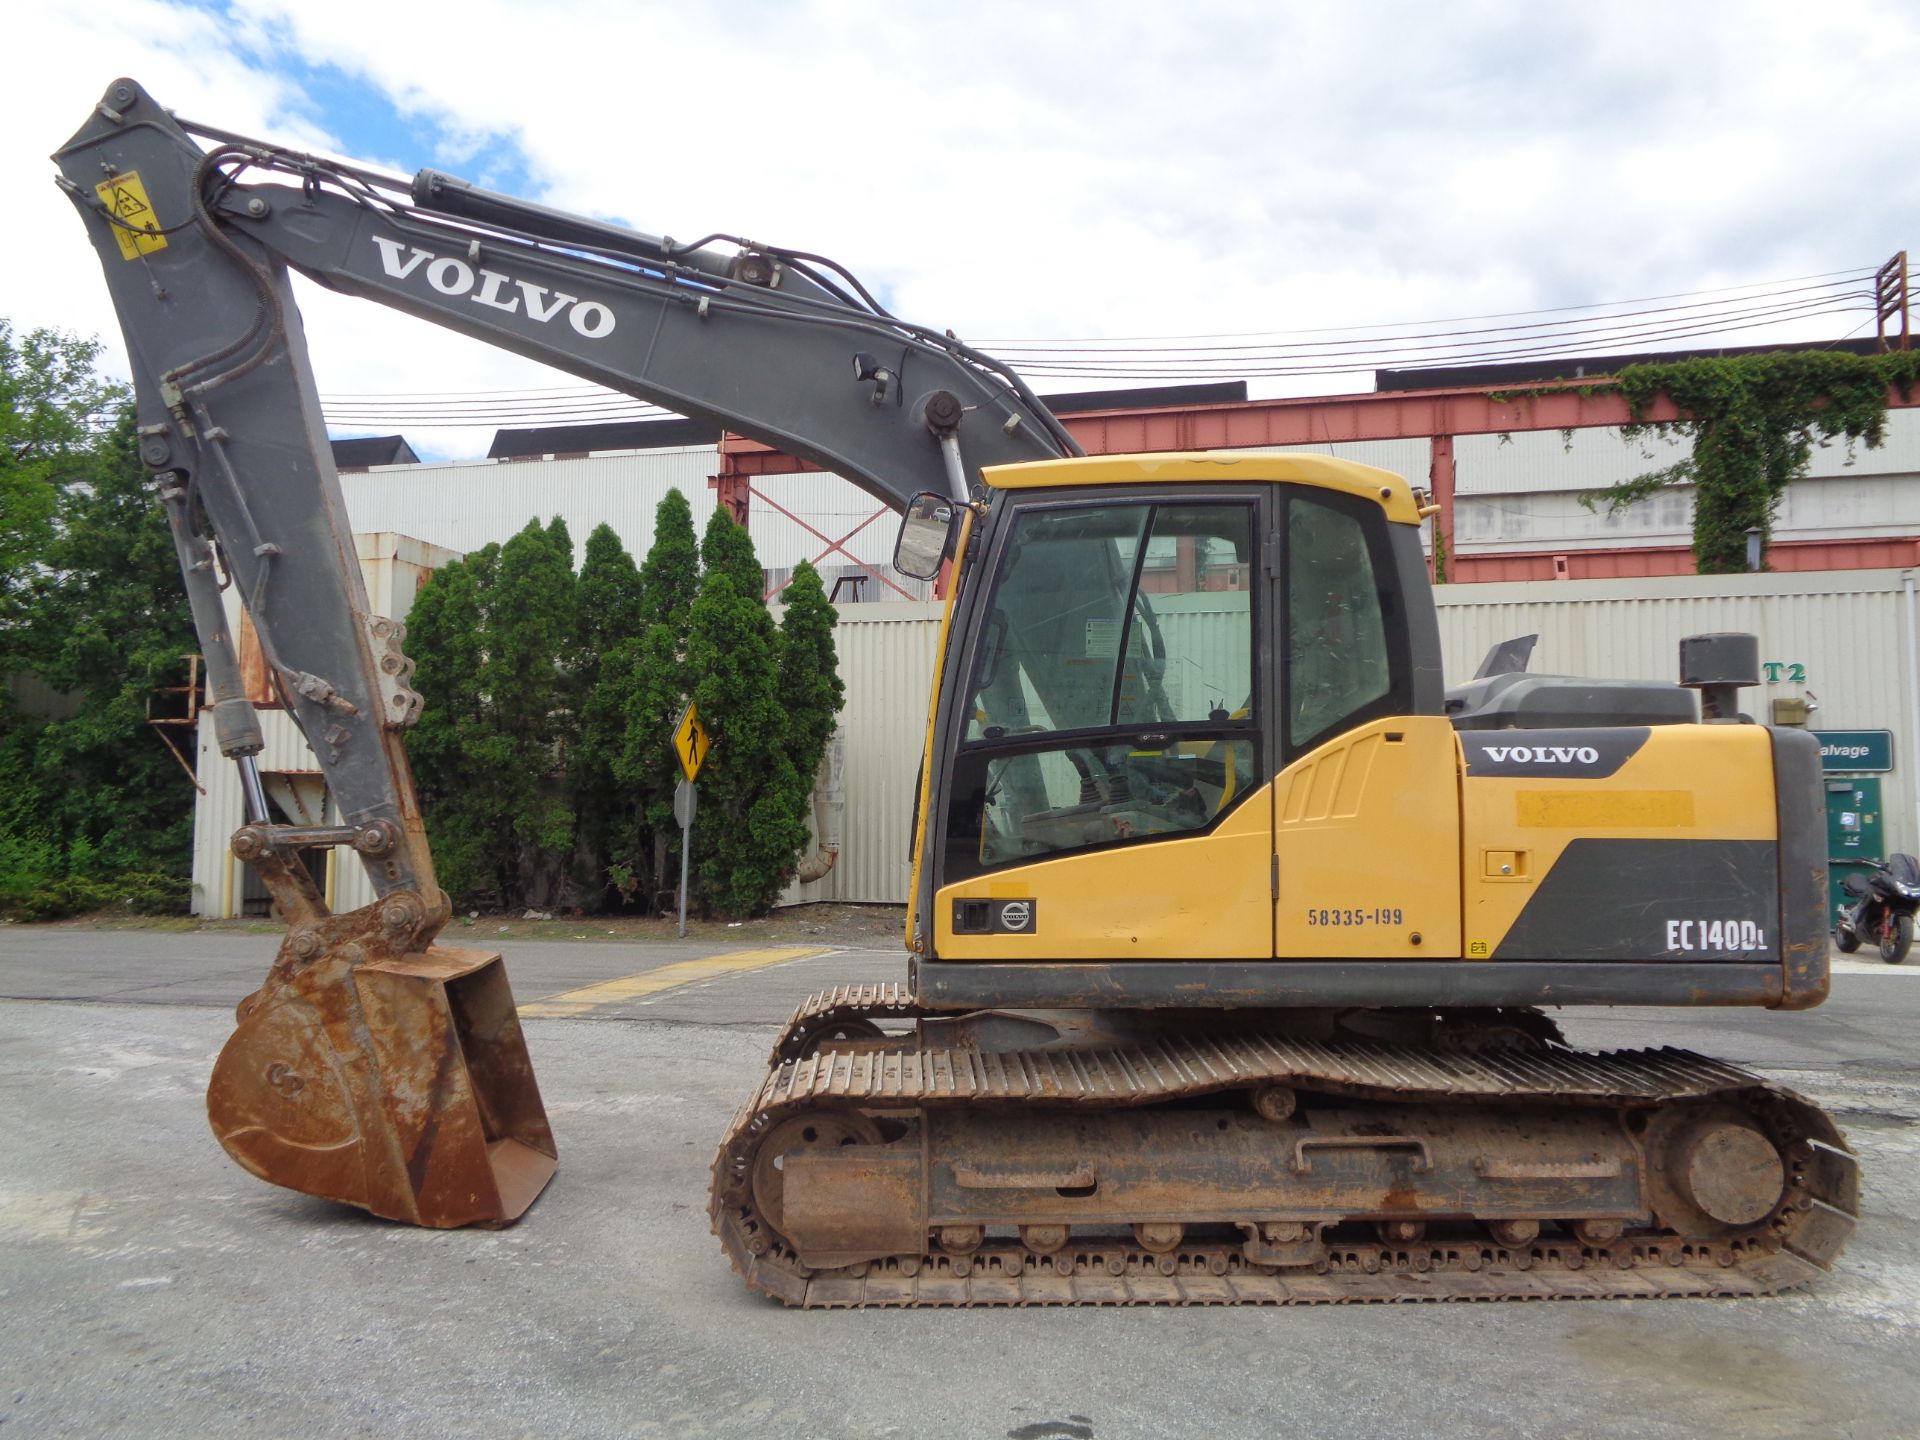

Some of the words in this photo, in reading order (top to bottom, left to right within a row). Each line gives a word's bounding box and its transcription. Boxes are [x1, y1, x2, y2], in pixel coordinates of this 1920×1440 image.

[372, 235, 616, 338] VOLVO
[1763, 662, 1806, 682] T2
[1482, 746, 1599, 763] VOLVO
[1819, 744, 1870, 759] alvage
[1308, 908, 1403, 926] 58335-199
